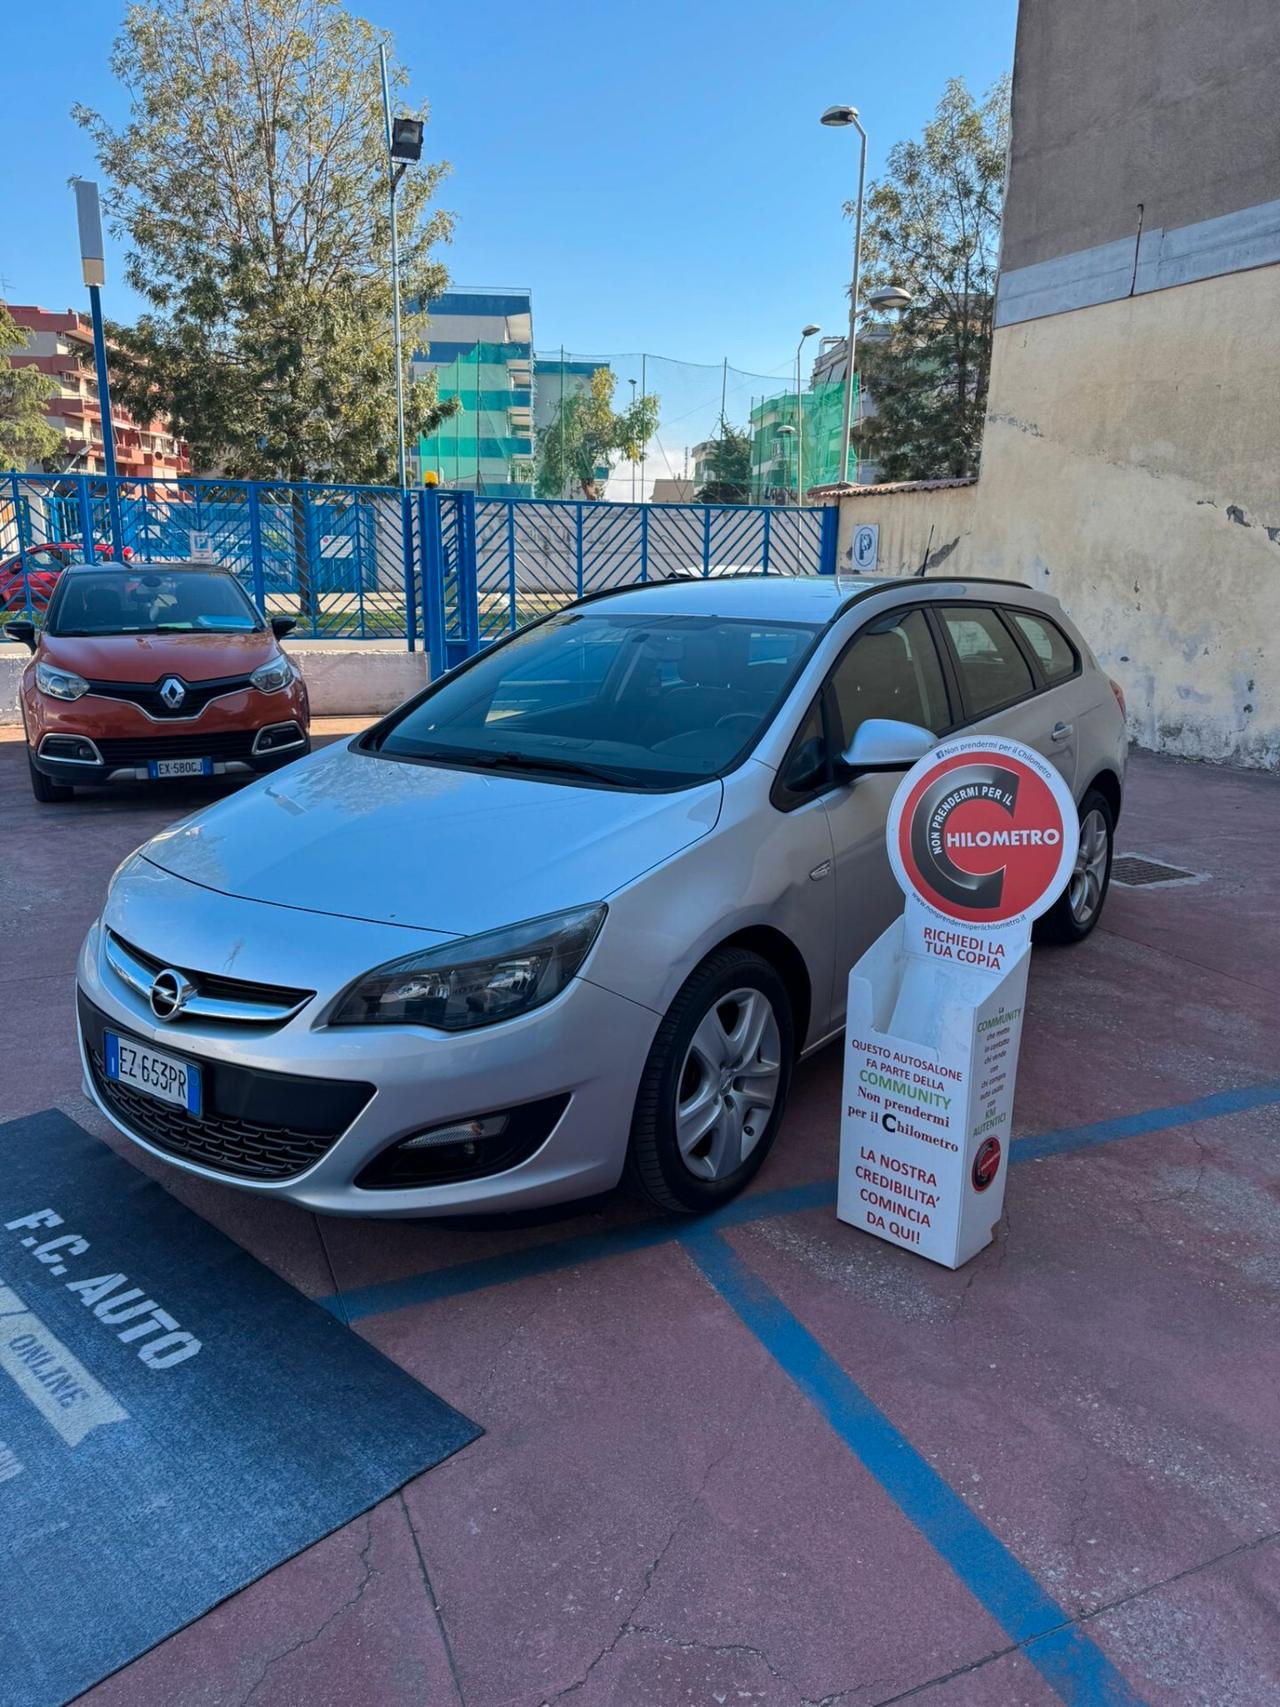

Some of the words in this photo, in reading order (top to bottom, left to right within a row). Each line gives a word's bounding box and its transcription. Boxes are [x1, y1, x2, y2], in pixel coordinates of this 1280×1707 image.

[944, 746, 959, 755] Non
[960, 740, 998, 751] prendermi
[998, 743, 1011, 751] per
[1012, 746, 1018, 754] il
[1017, 749, 1052, 779] Chilometro
[933, 786, 979, 830] PRENDERMI
[982, 786, 1002, 799] PER
[1002, 793, 1013, 806] IL
[929, 831, 942, 855] NON
[923, 927, 984, 951] RICHIEDI
[988, 942, 1005, 957] LA
[925, 940, 952, 958] TUA
[957, 949, 1001, 970] COPIA
[119, 1046, 137, 1078] EZ
[851, 1039, 891, 1059] QUESTO
[893, 1052, 963, 1082] AUTOSALONE
[866, 1058, 878, 1070] FA
[880, 1062, 911, 1080] PARTE
[913, 1073, 945, 1092] DELLA
[857, 1086, 881, 1104] Non
[884, 1098, 950, 1128] prendermi
[859, 1069, 951, 1111] COMMUNITY
[847, 1105, 867, 1119] per
[870, 1111, 879, 1125] il
[882, 1113, 959, 1153] Chilometro
[855, 1165, 940, 1208] CREDIBILITA'
[860, 1146, 876, 1164] LA
[880, 1154, 937, 1187] NOSTRA
[860, 1188, 931, 1228] COMINCIA
[866, 1211, 886, 1230] DA
[889, 1221, 920, 1245] QUI!
[4, 1208, 91, 1276] F.C.
[65, 1272, 203, 1369] AUTO
[8, 1333, 91, 1410] ONLINE
